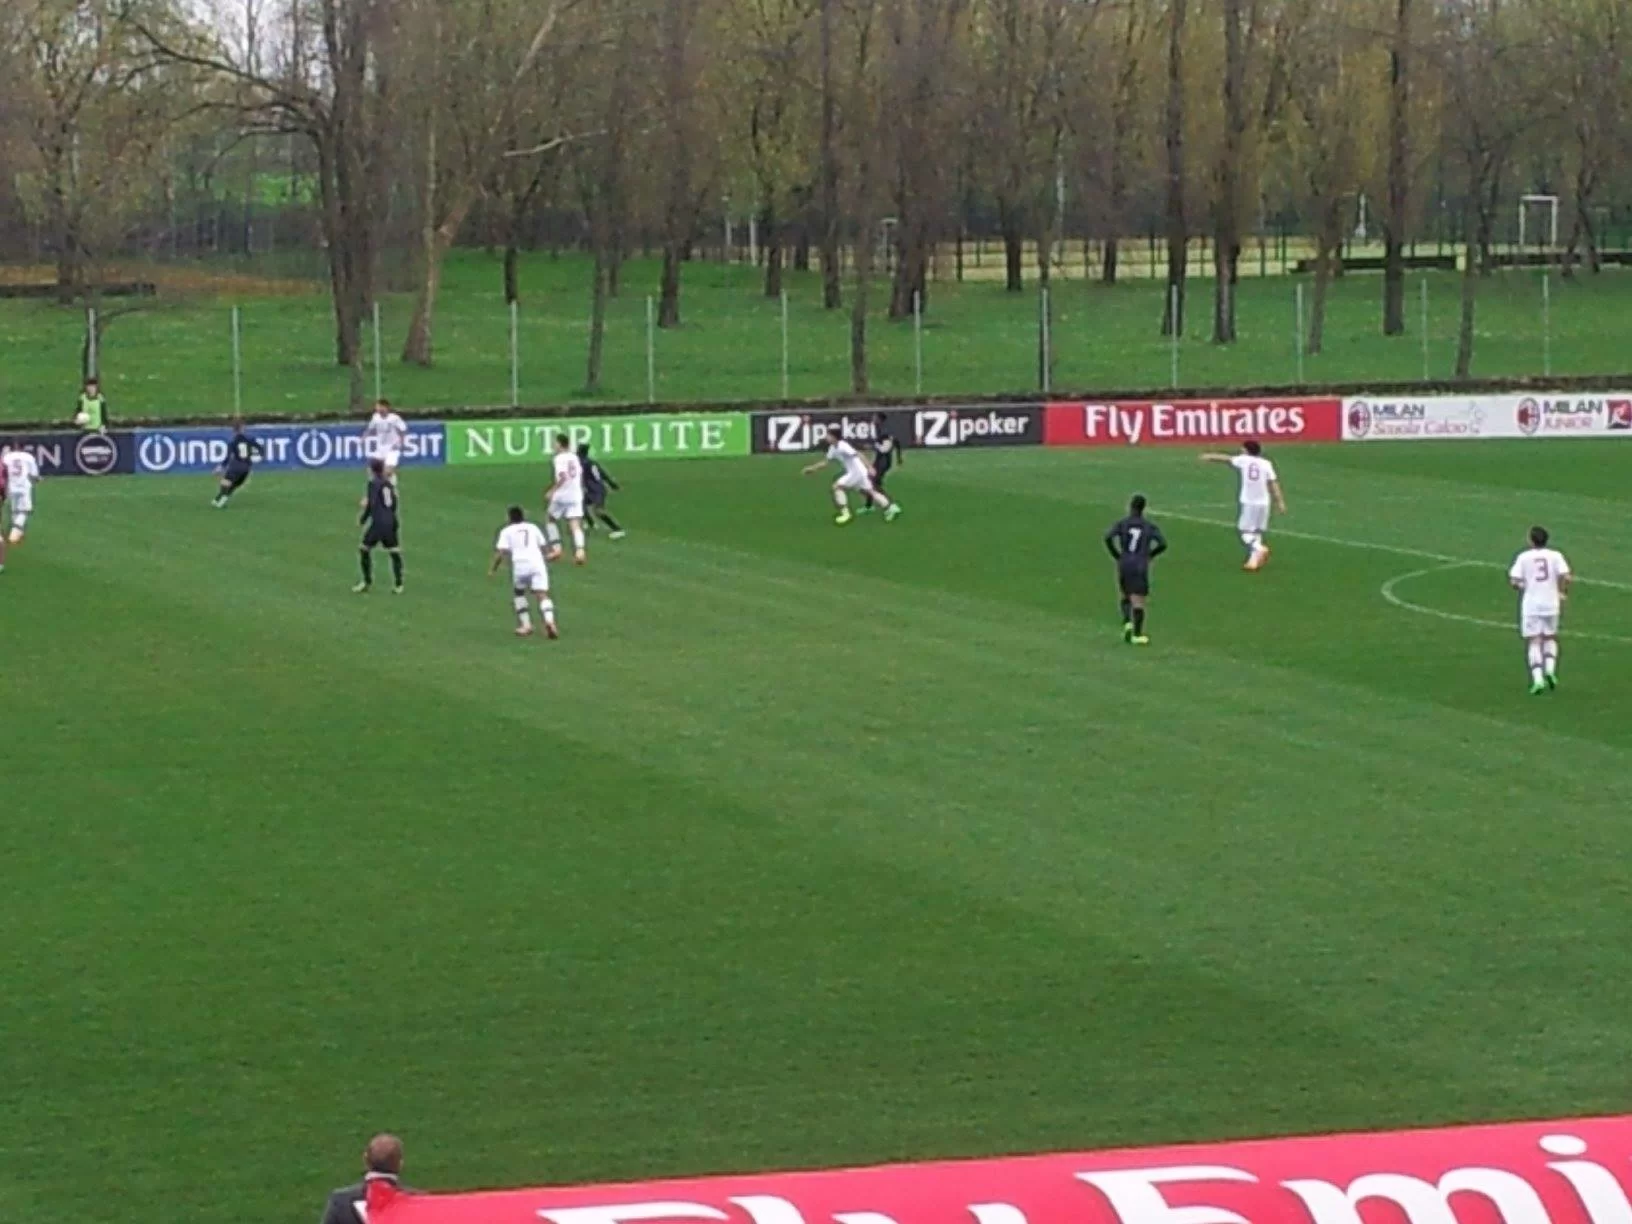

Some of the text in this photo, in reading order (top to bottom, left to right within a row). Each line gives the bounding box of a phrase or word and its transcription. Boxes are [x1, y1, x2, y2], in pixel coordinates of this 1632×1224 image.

[1085, 402, 1305, 443] Fly Emirates
[335, 433, 444, 460] INDSIT
[465, 420, 726, 457] NUTRILITE
[517, 529, 529, 547] 7
[1128, 527, 1142, 552] 7
[1534, 557, 1549, 581] 3
